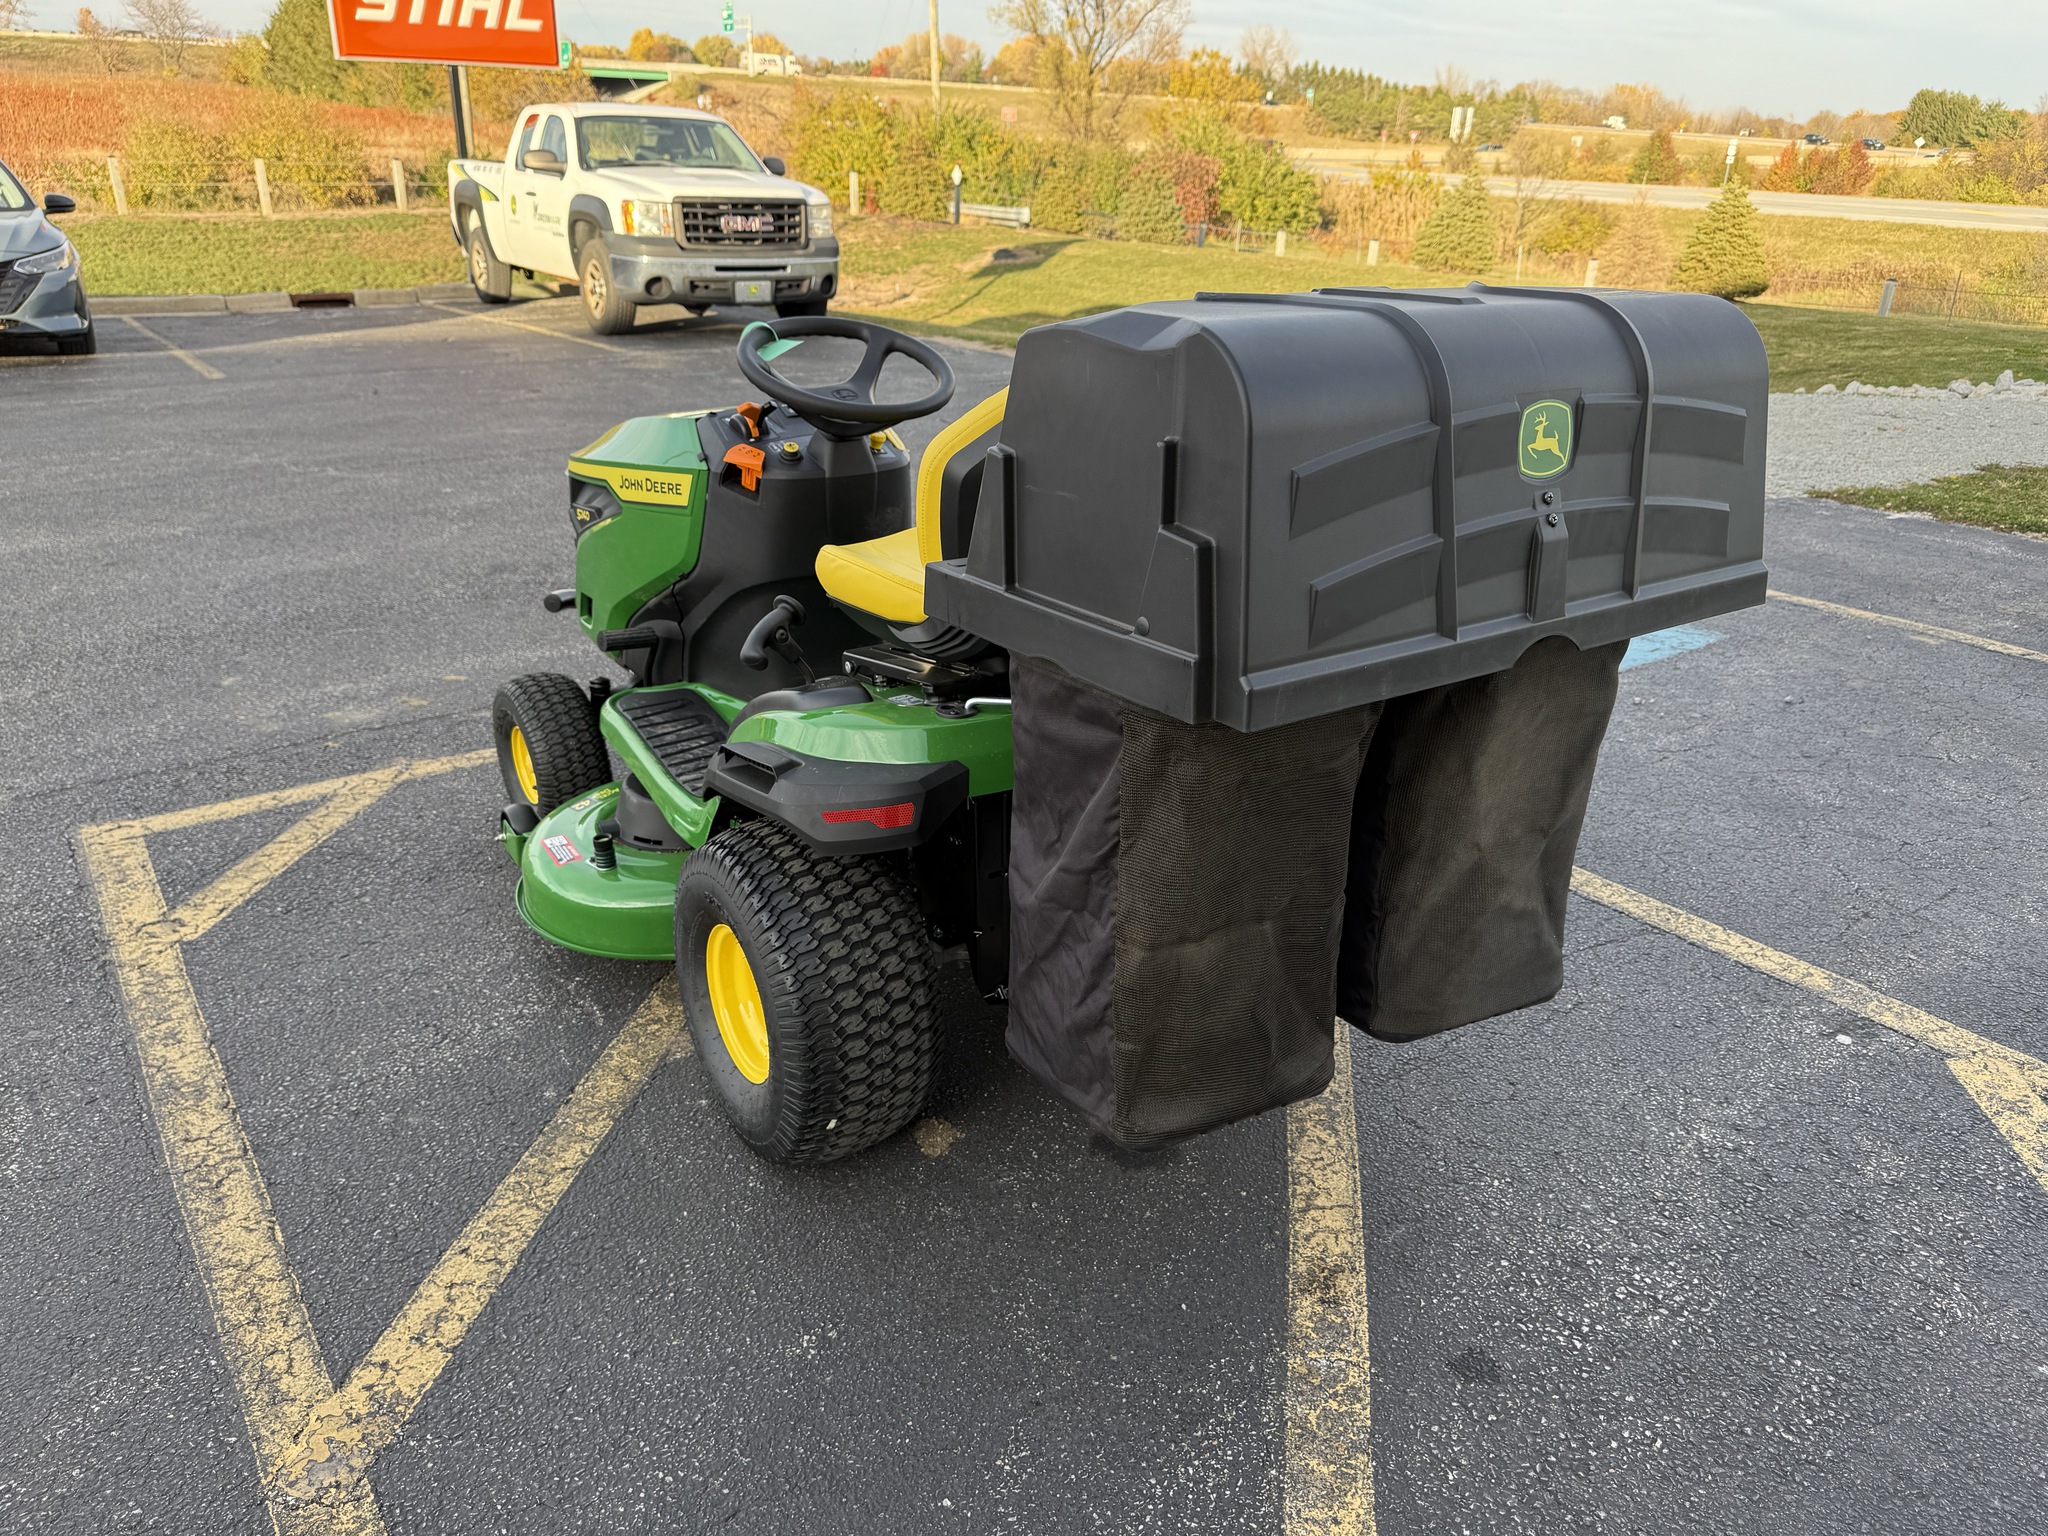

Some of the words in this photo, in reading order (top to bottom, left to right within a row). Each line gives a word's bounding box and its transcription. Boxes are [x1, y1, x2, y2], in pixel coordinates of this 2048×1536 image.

[720, 214, 774, 232] GMC
[619, 475, 643, 491] JOHN
[645, 478, 682, 495] DEERE
